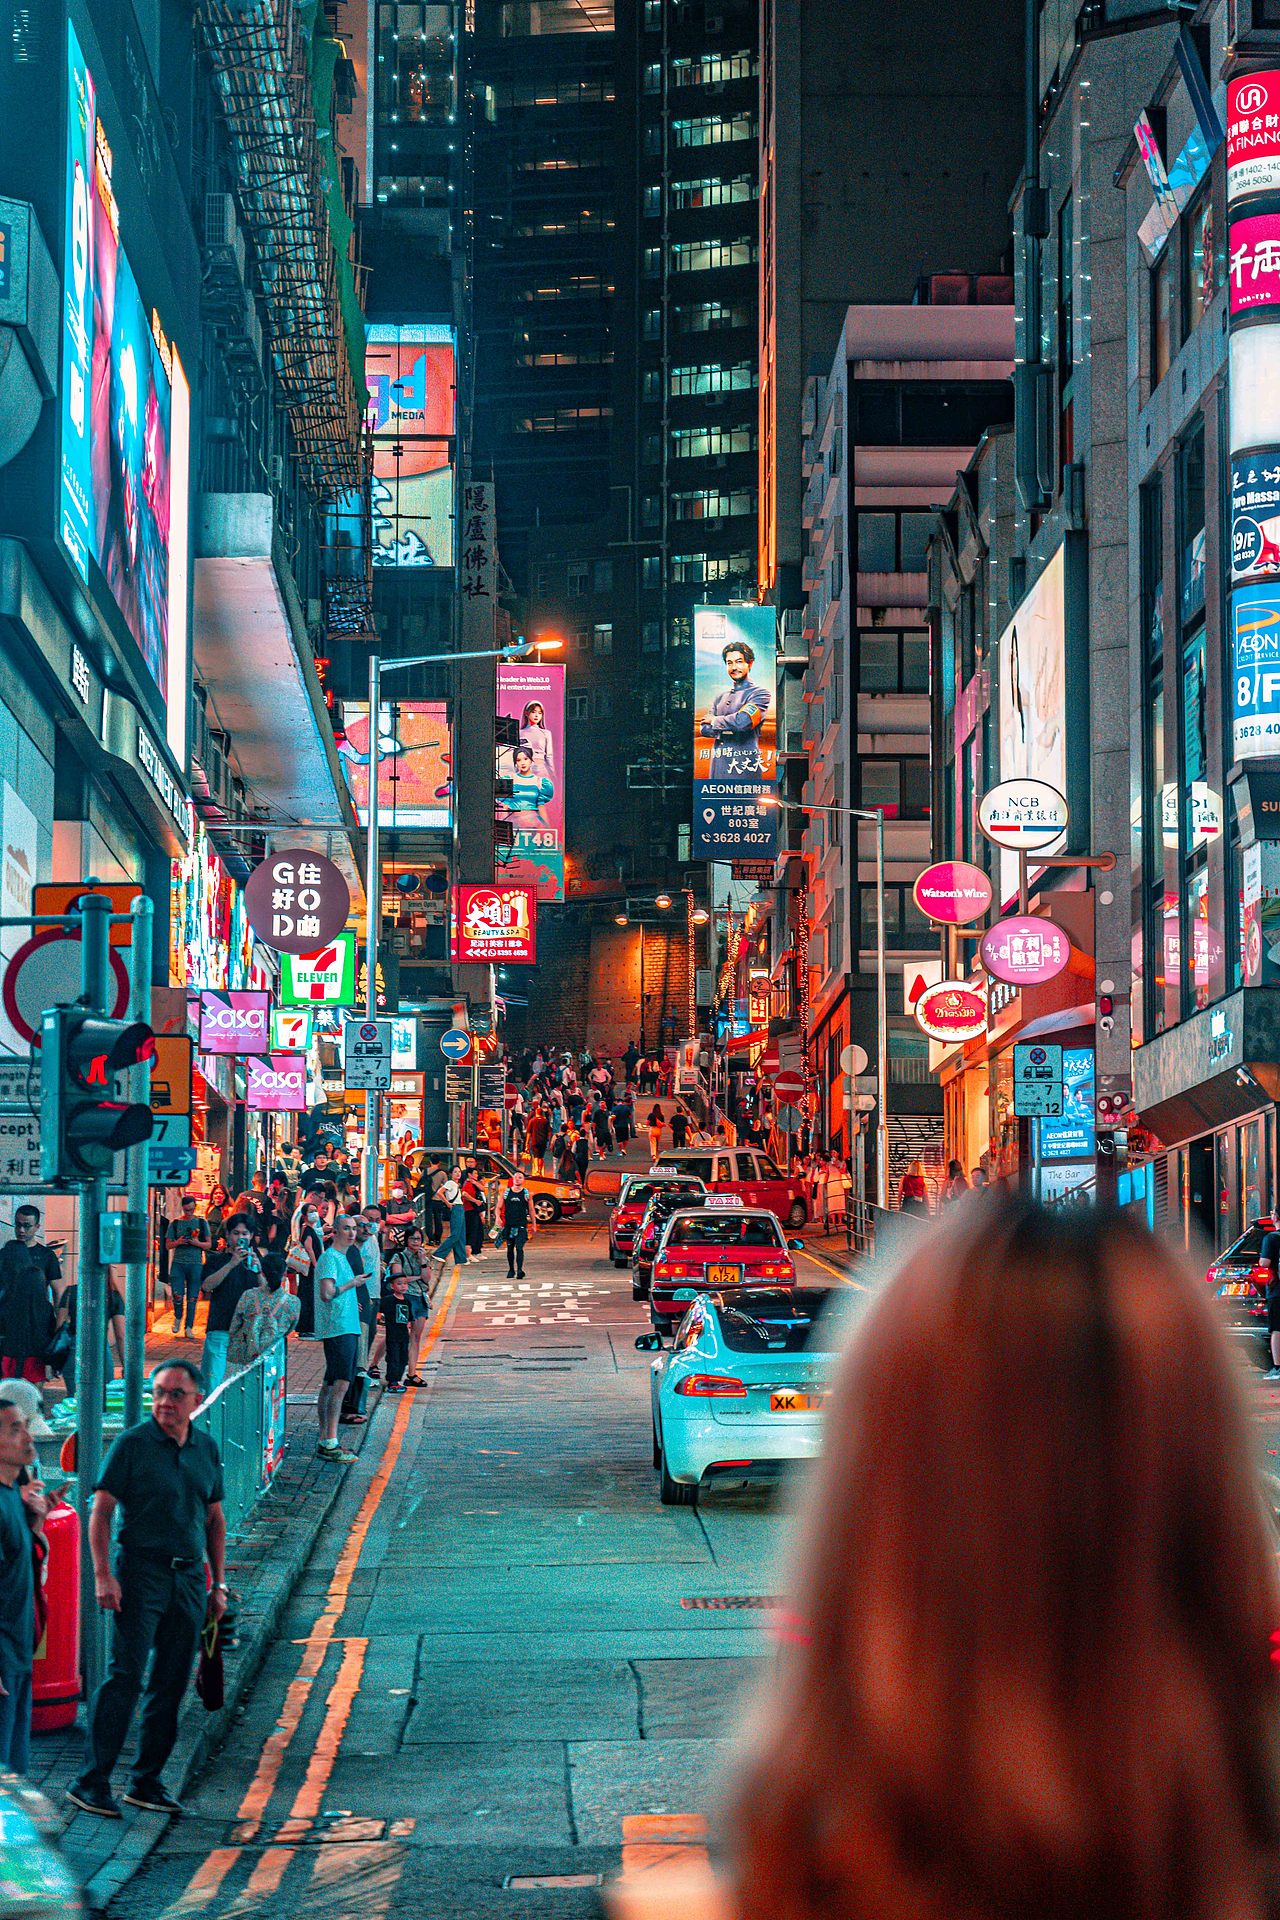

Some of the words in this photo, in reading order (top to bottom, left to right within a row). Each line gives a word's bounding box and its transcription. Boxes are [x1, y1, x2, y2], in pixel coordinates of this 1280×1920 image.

[1008, 797, 1040, 808] NCB
[728, 818, 759, 829] 803室
[713, 832, 741, 843] 3628
[743, 832, 772, 843] 4027
[920, 887, 963, 898] Watson's
[963, 888, 988, 898] Wine
[374, 1059, 382, 1070] 7
[375, 1076, 388, 1087] 12
[1045, 1085, 1053, 1096] 7
[1046, 1102, 1060, 1114] 12
[708, 1197, 740, 1205] TAXI
[713, 1274, 736, 1282] 6124
[477, 1282, 594, 1292] BUS
[774, 1396, 796, 1409] XK
